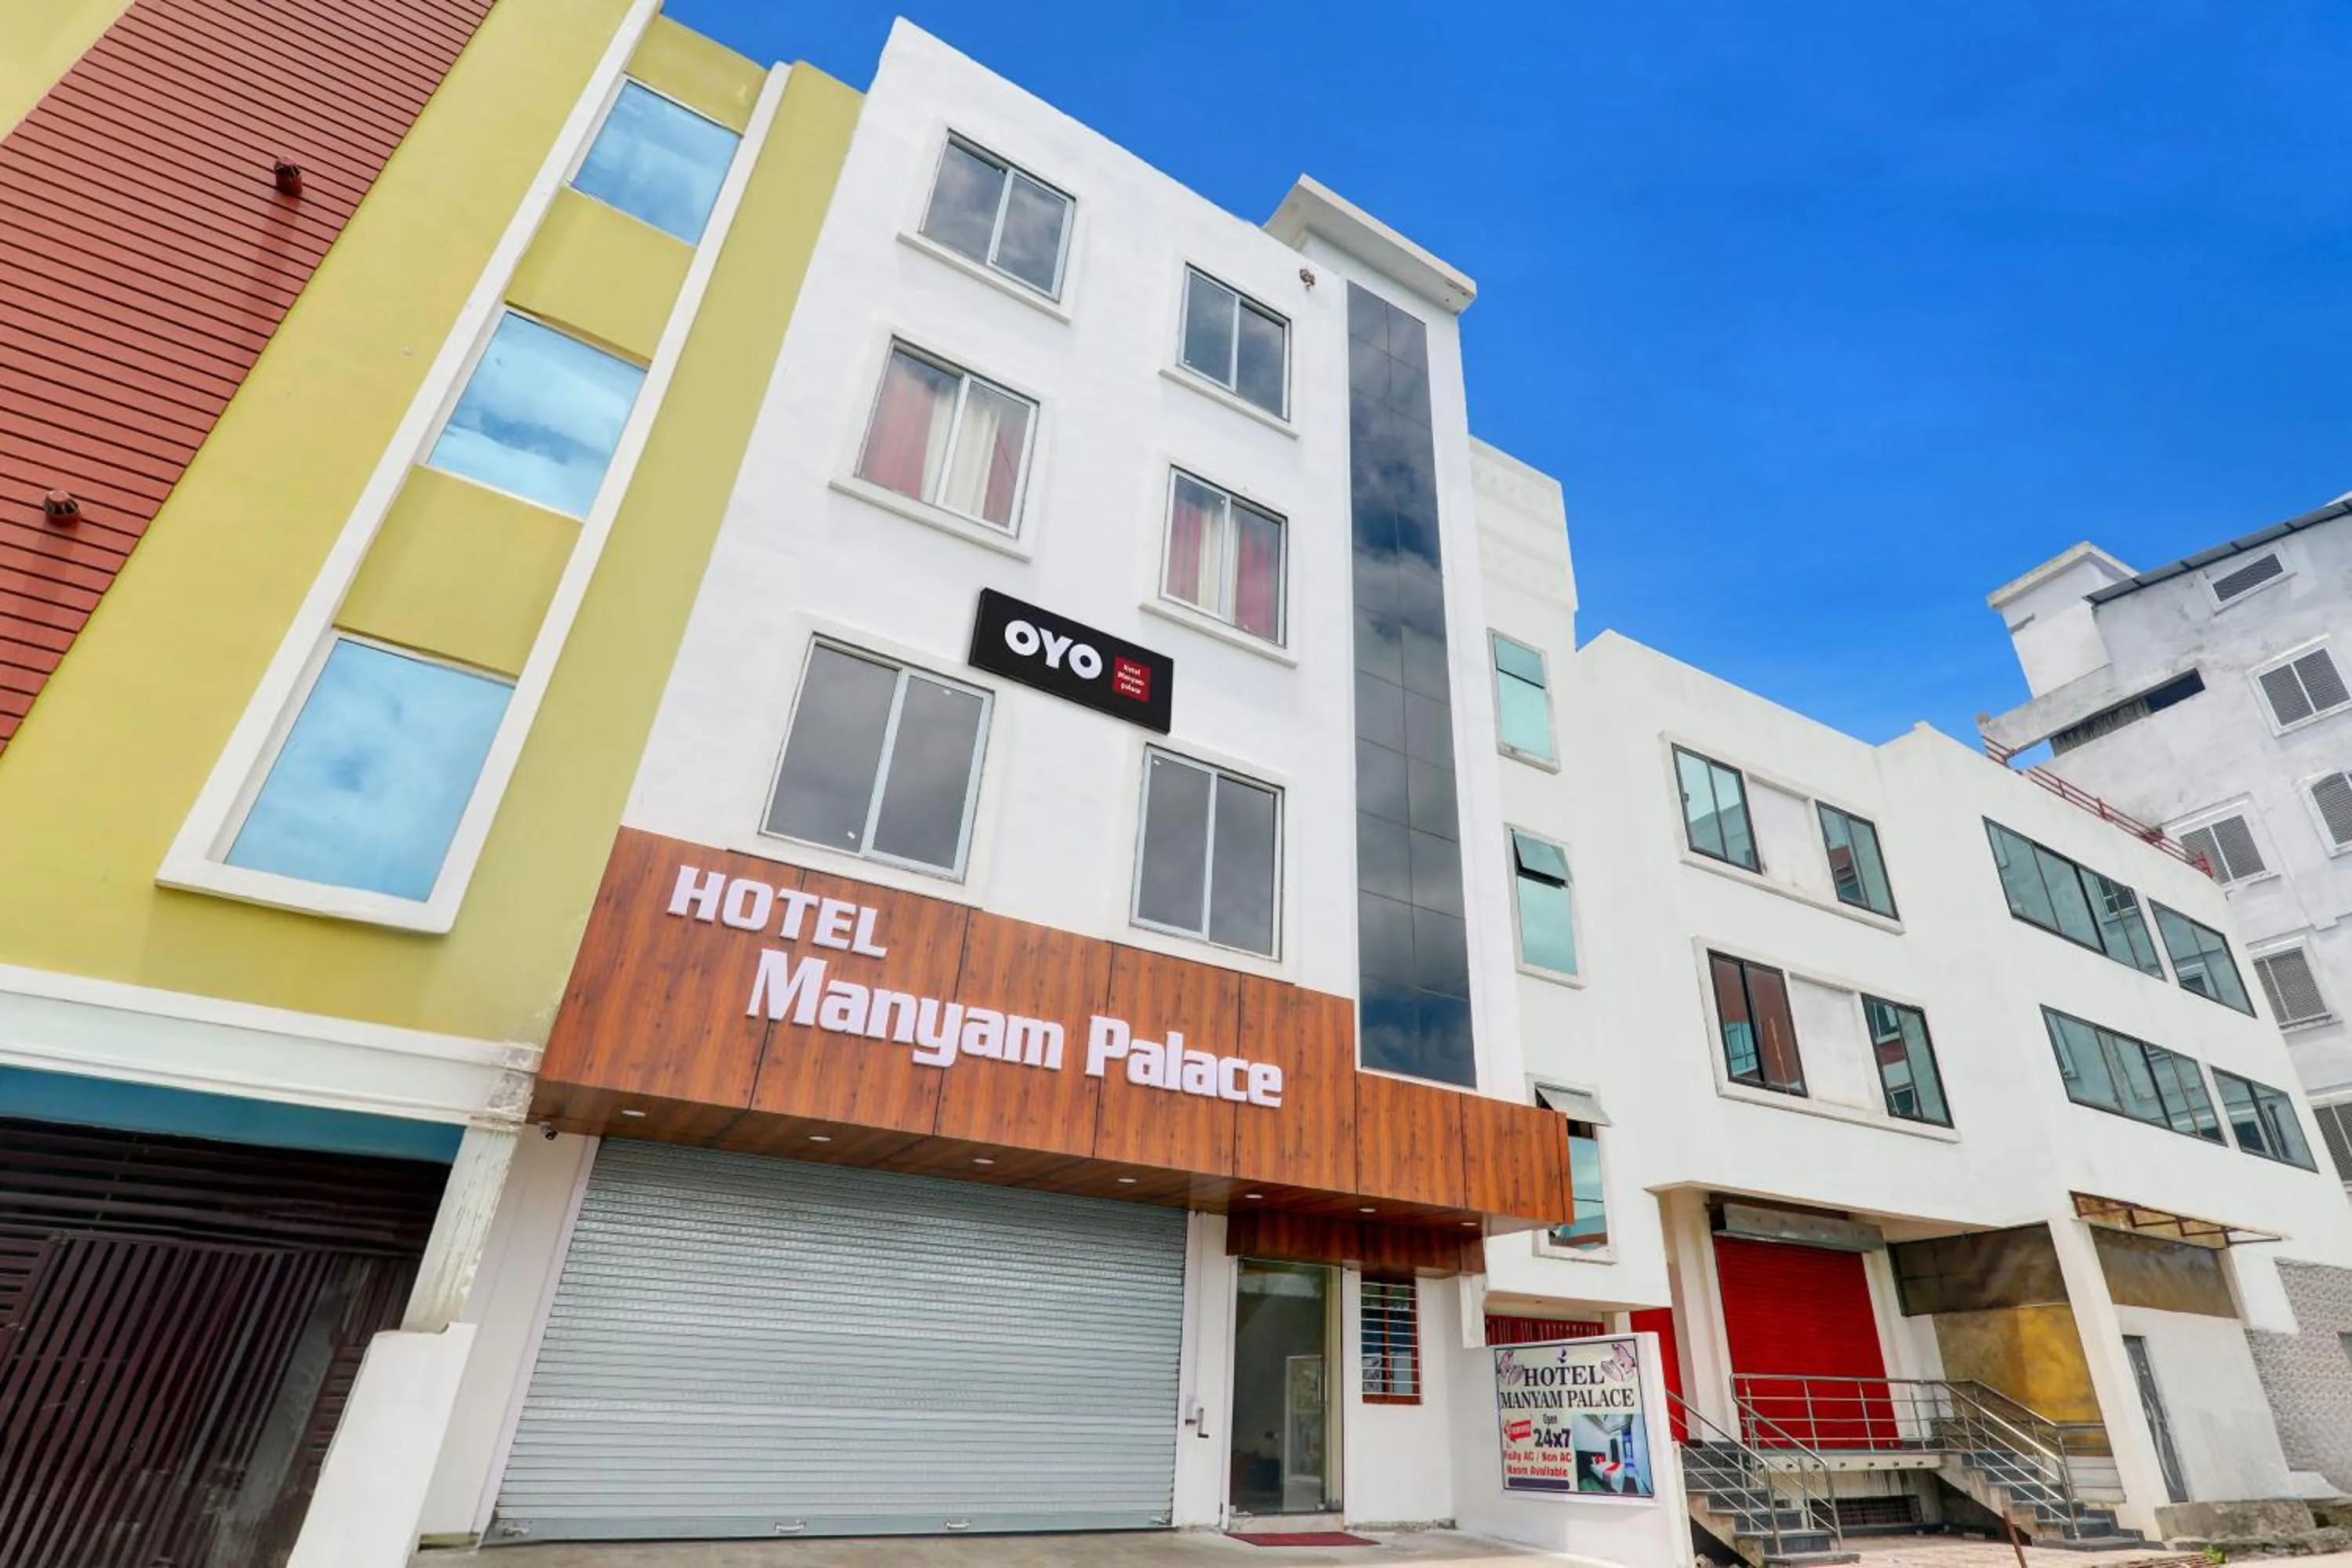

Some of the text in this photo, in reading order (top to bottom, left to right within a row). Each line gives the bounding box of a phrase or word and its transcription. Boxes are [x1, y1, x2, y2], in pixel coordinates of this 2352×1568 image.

[1005, 619, 1103, 680] OYO
[667, 865, 887, 958] HOTEL
[746, 948, 1283, 1108] Manyam Palace
[1524, 1365, 1605, 1387] HOTEL
[1501, 1388, 1635, 1409] MANYAM PALACE
[1533, 1428, 1571, 1448] 24x7
